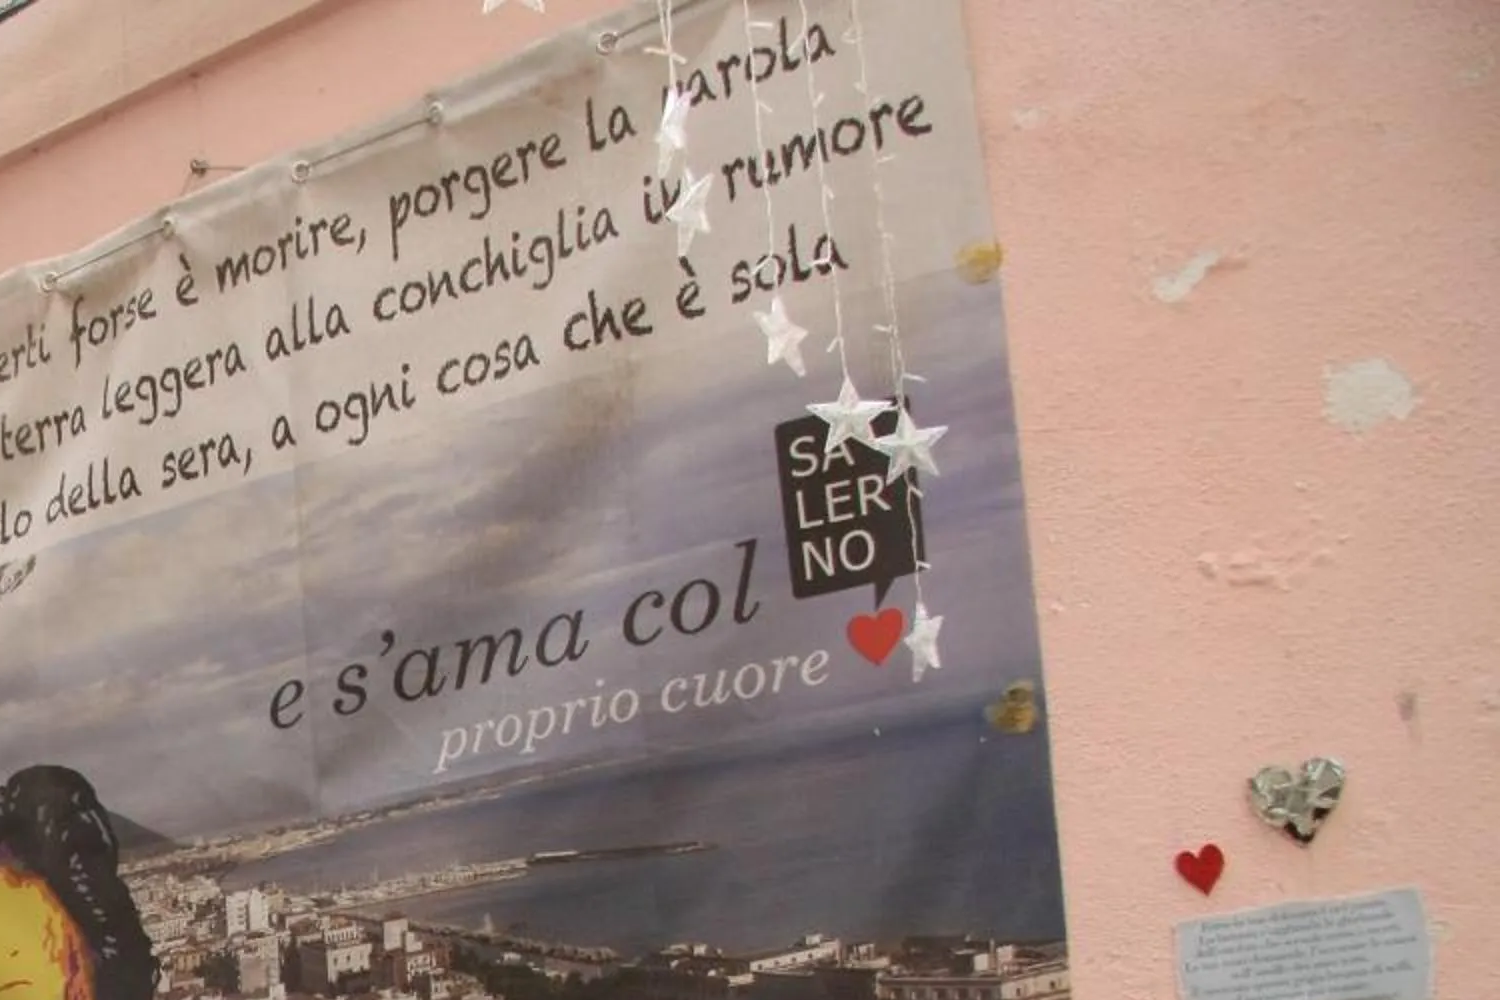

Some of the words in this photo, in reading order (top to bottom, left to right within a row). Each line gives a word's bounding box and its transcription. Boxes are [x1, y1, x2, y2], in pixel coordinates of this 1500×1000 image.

[0, 402, 87, 462] terra
[100, 352, 247, 426] leggera
[266, 297, 352, 360] alla
[372, 204, 619, 322] conchiglia
[721, 94, 934, 202] rumore
[68, 284, 158, 369] forse
[174, 254, 200, 306] è
[215, 210, 368, 294] morire,
[388, 132, 567, 260] porgere
[586, 98, 637, 152] la
[46, 462, 143, 524] della
[160, 430, 255, 490] sera,
[271, 410, 298, 447] a
[314, 363, 417, 446] ogni
[436, 340, 541, 394] cosa
[562, 288, 654, 352] che
[730, 222, 850, 304] sola
[796, 474, 891, 530] LER
[801, 530, 876, 582] NO
[269, 677, 303, 730] e
[333, 608, 588, 717] s'ama
[623, 538, 760, 647] col
[433, 680, 640, 774] proprio
[660, 646, 830, 714] cuore
